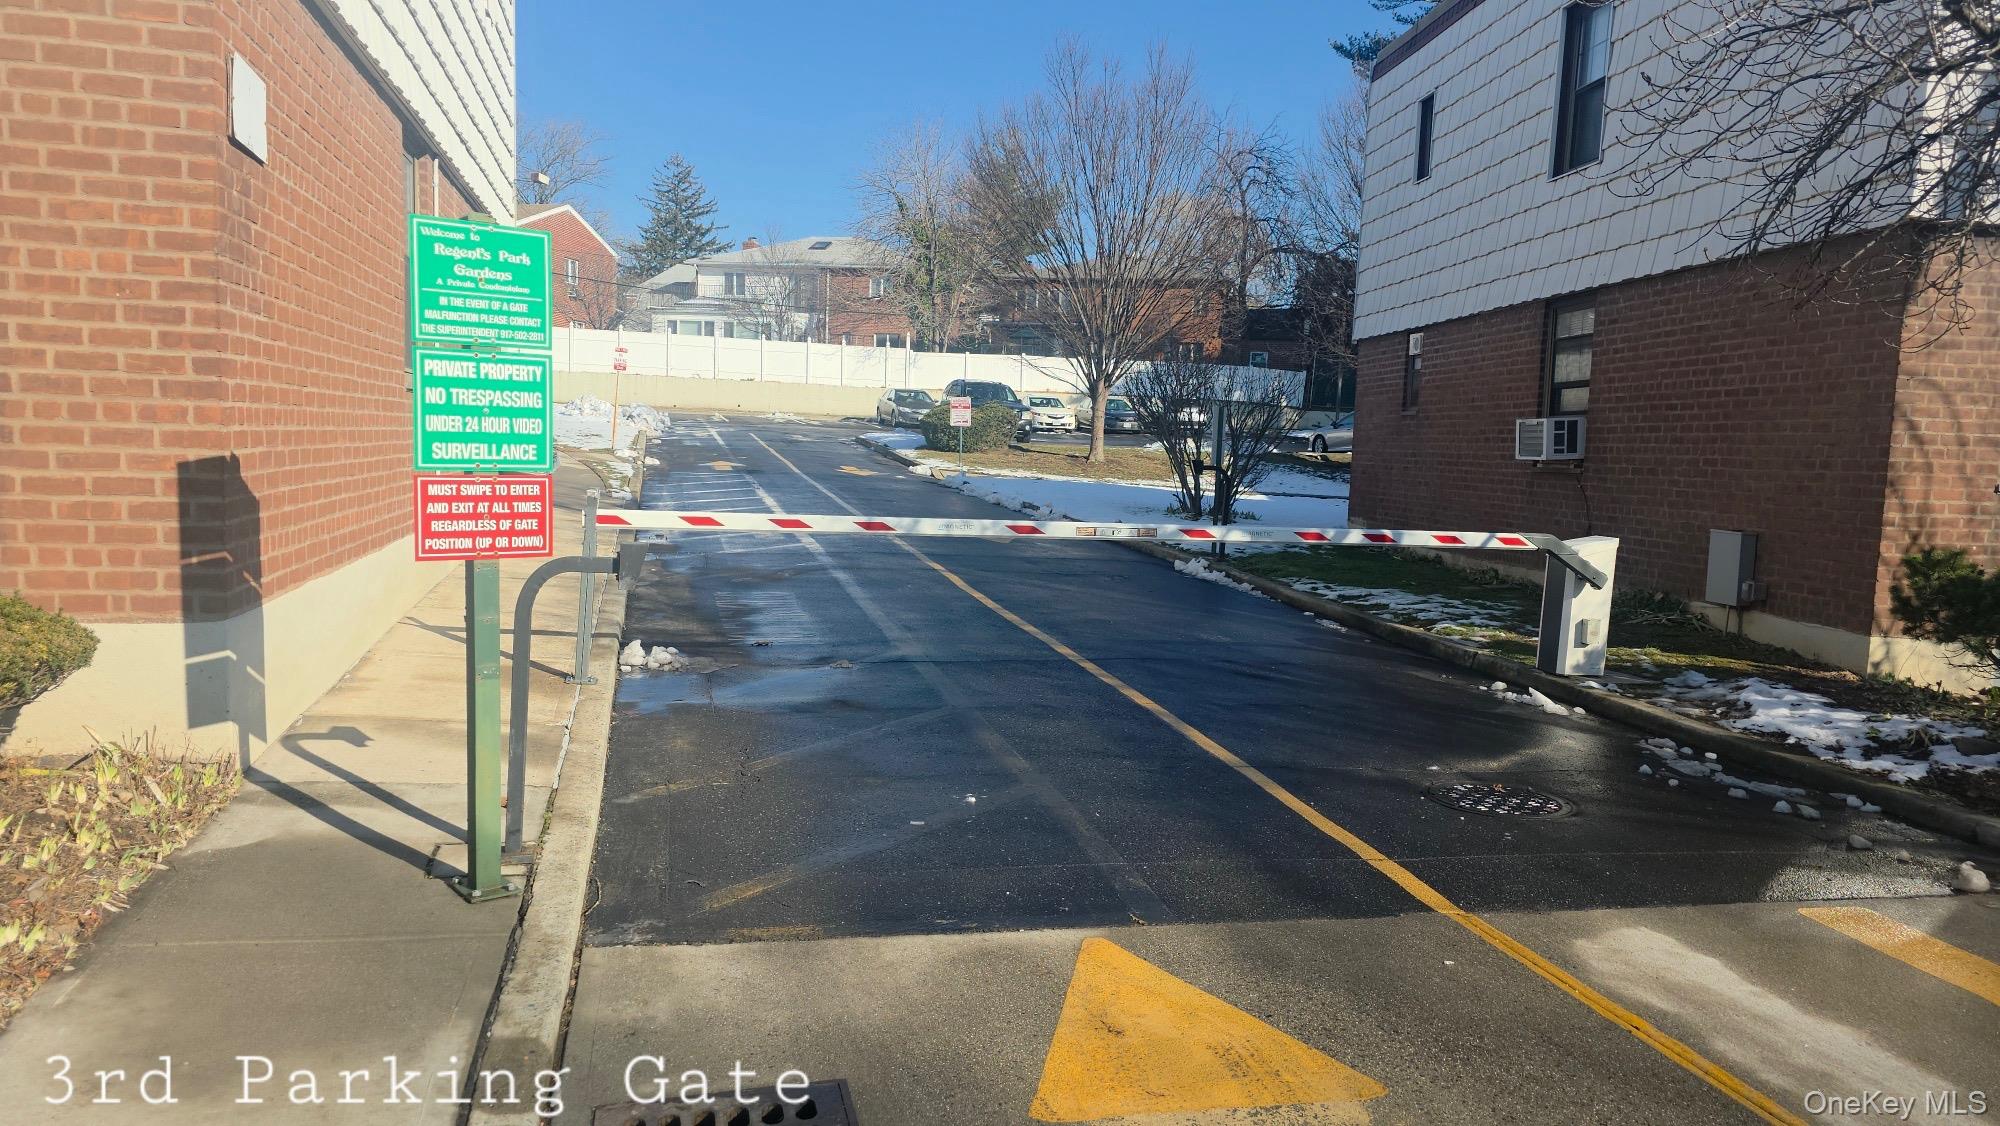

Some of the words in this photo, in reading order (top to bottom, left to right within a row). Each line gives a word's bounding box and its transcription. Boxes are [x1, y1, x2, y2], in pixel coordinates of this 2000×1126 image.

[420, 226, 465, 240] Welcome
[470, 232, 480, 241] to
[433, 242, 491, 260] Regent's
[498, 250, 531, 266] Park
[453, 263, 512, 281] Gardens
[436, 277, 443, 285] A
[447, 278, 476, 289] Private
[478, 281, 531, 294] Condominium
[439, 296, 448, 306] IN
[449, 297, 465, 307] THE
[466, 298, 489, 309] EVENT
[491, 300, 501, 310] OF
[502, 301, 508, 311] A
[509, 302, 529, 313] GATE
[424, 309, 479, 323] MALFUNCTION
[480, 313, 509, 325] PLEASE
[509, 315, 542, 328] CONTACT
[421, 323, 437, 334] THE
[437, 324, 500, 338] SUPERINTENDENT
[500, 330, 545, 341] 917-502-2811
[424, 358, 477, 379] PRIVATE
[480, 362, 543, 382] PROPERTY
[425, 386, 446, 405] NO
[449, 387, 543, 409] TRESPASSING
[425, 414, 463, 433] UNDER
[465, 415, 479, 433] 24
[481, 416, 510, 434] HOUR
[512, 417, 543, 435] VIDEO
[431, 442, 538, 461] SURVEILLANCE
[427, 484, 457, 496] MUST
[460, 484, 493, 496] SWIPE
[494, 484, 507, 496] TO
[510, 484, 540, 496] ENTER
[426, 502, 449, 514] AND
[451, 502, 475, 514] EXIT
[477, 502, 489, 513] AT
[492, 502, 510, 513] ALL
[512, 501, 542, 513] TIMES
[431, 519, 497, 532] REGARDLESS
[499, 519, 512, 531] OF
[514, 518, 538, 530] GATE
[425, 538, 472, 550] POSITION
[475, 536, 493, 549] (UP
[495, 537, 509, 548] OR
[511, 535, 544, 548] DOWN)
